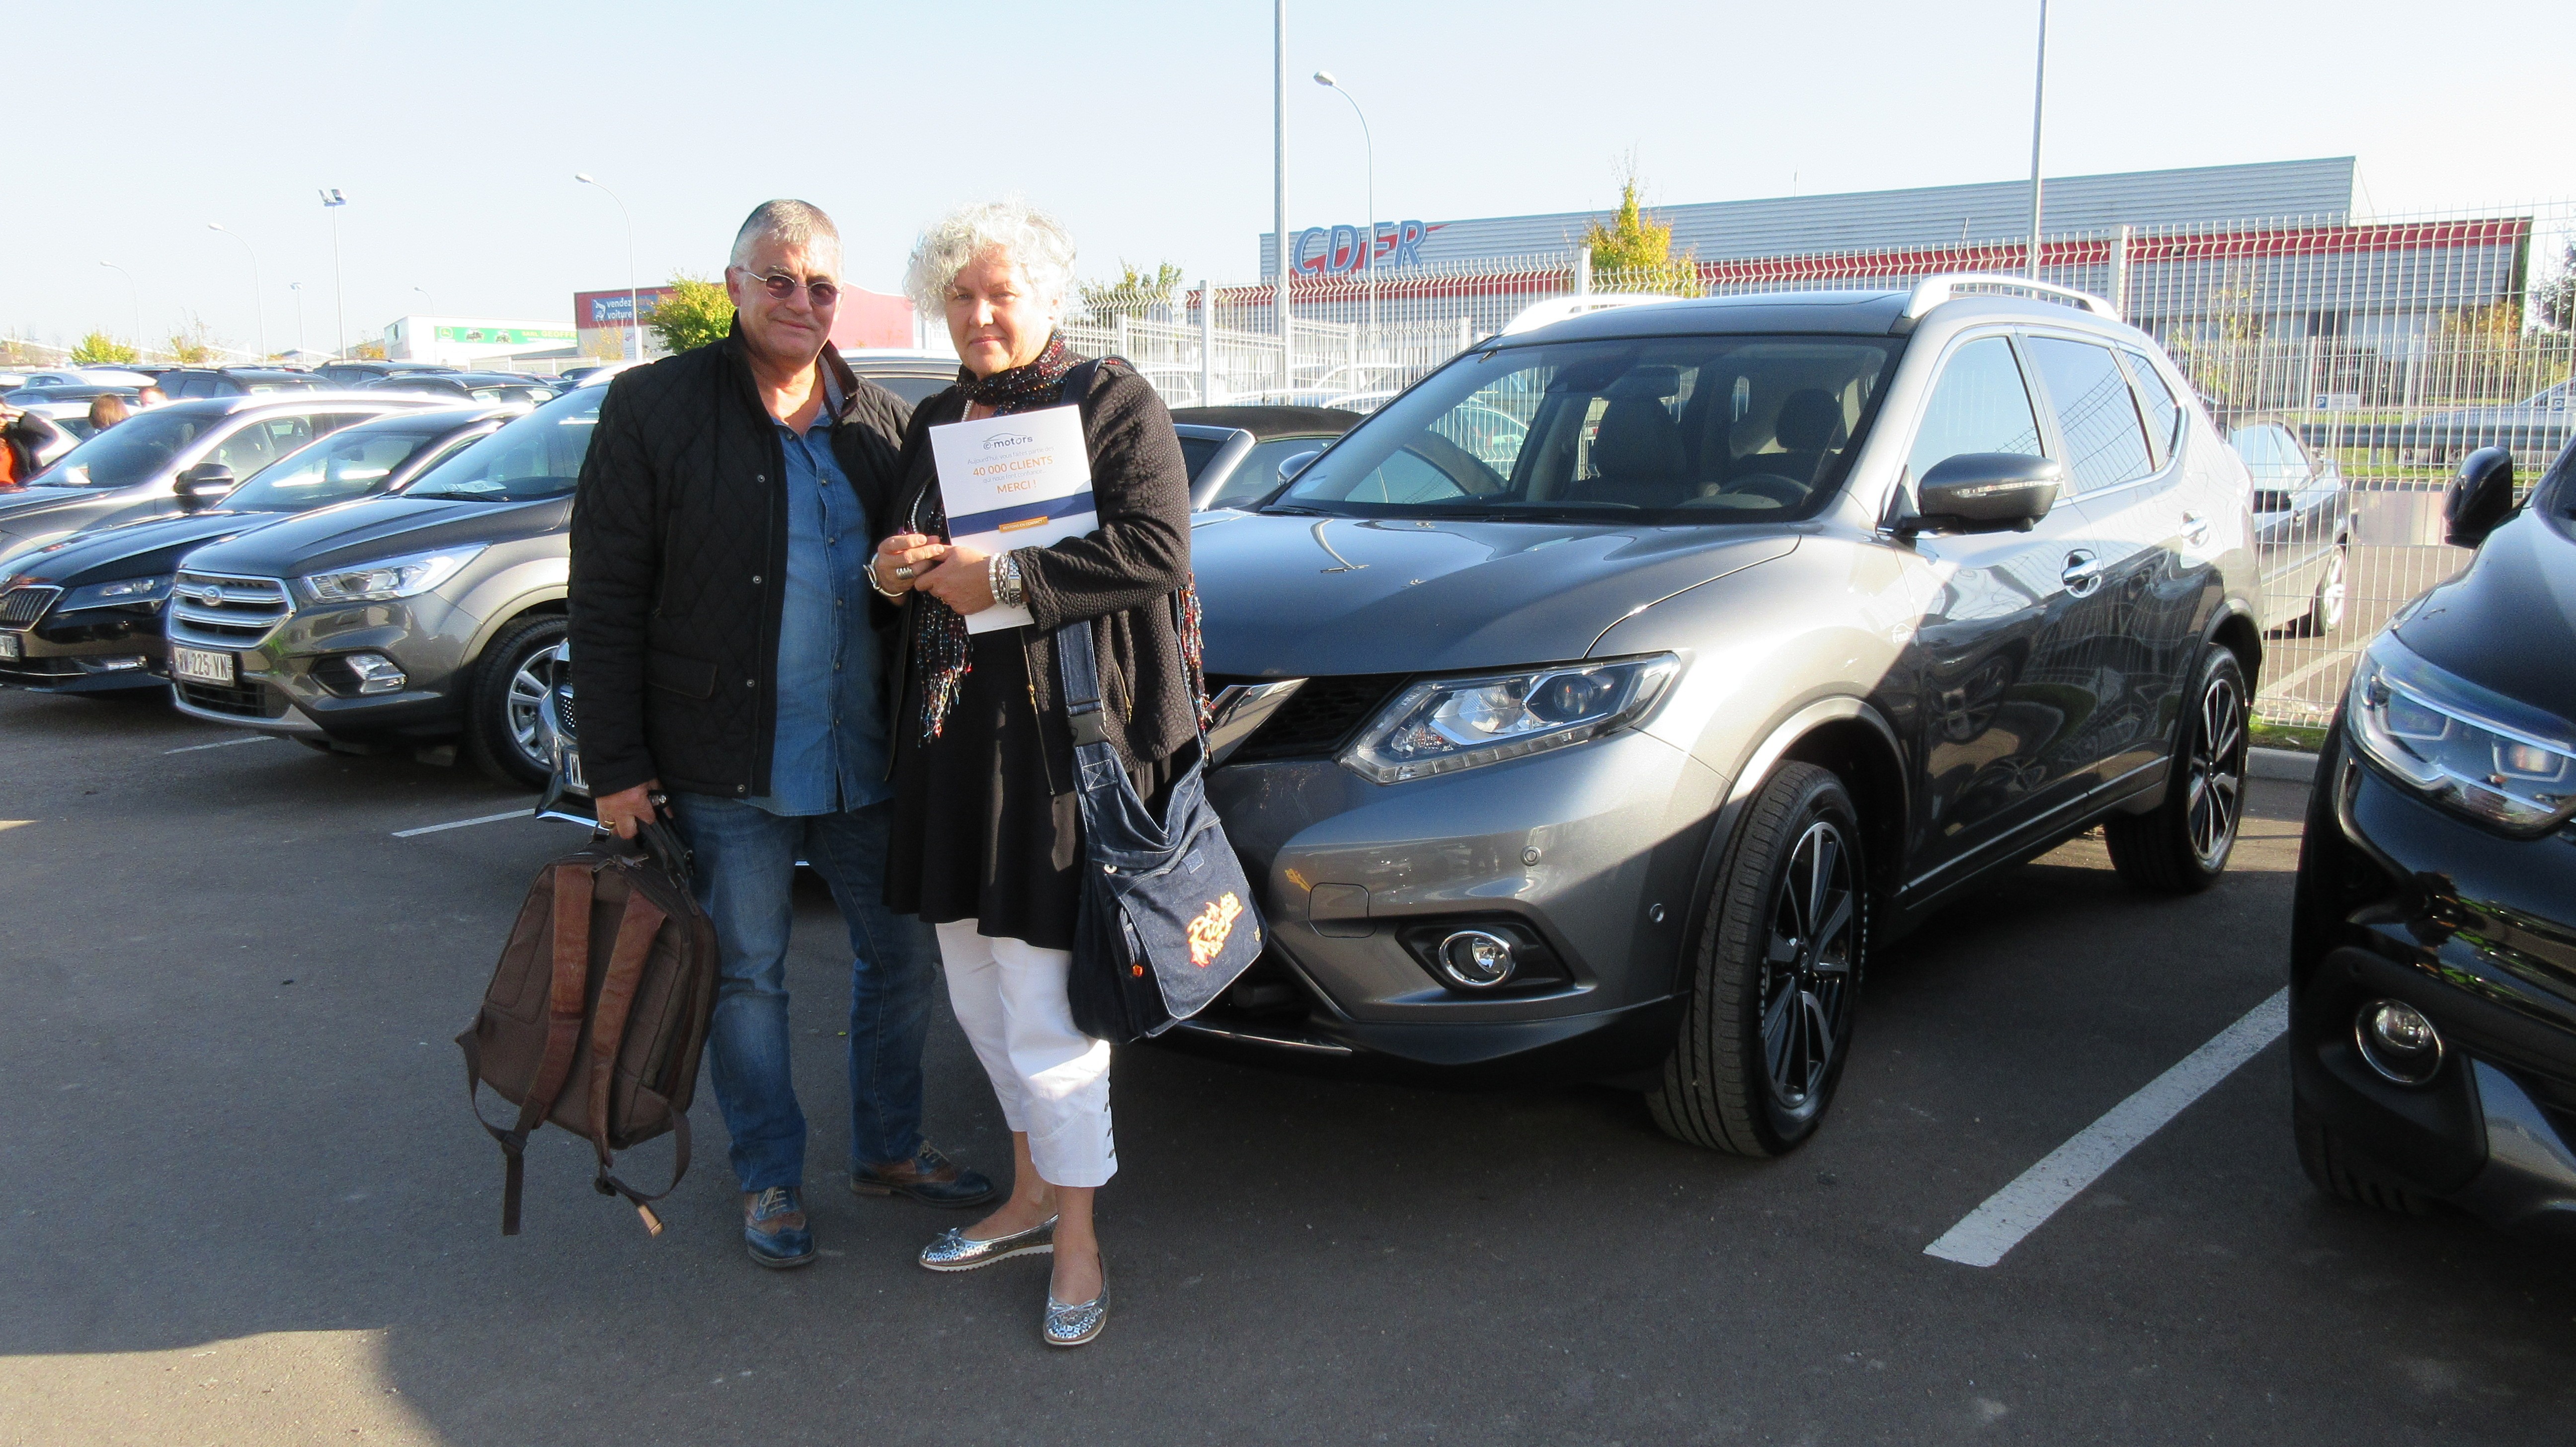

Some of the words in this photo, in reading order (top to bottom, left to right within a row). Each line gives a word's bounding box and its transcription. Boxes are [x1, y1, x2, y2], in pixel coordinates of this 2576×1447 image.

[1292, 220, 1427, 275] CDER
[607, 298, 632, 308] vendez
[607, 310, 632, 319] voiture
[983, 436, 1033, 450] e-motors
[973, 467, 986, 477] 40
[988, 463, 1007, 475] 000
[1009, 456, 1053, 471] CLIENTS
[997, 481, 1031, 494] MERCI
